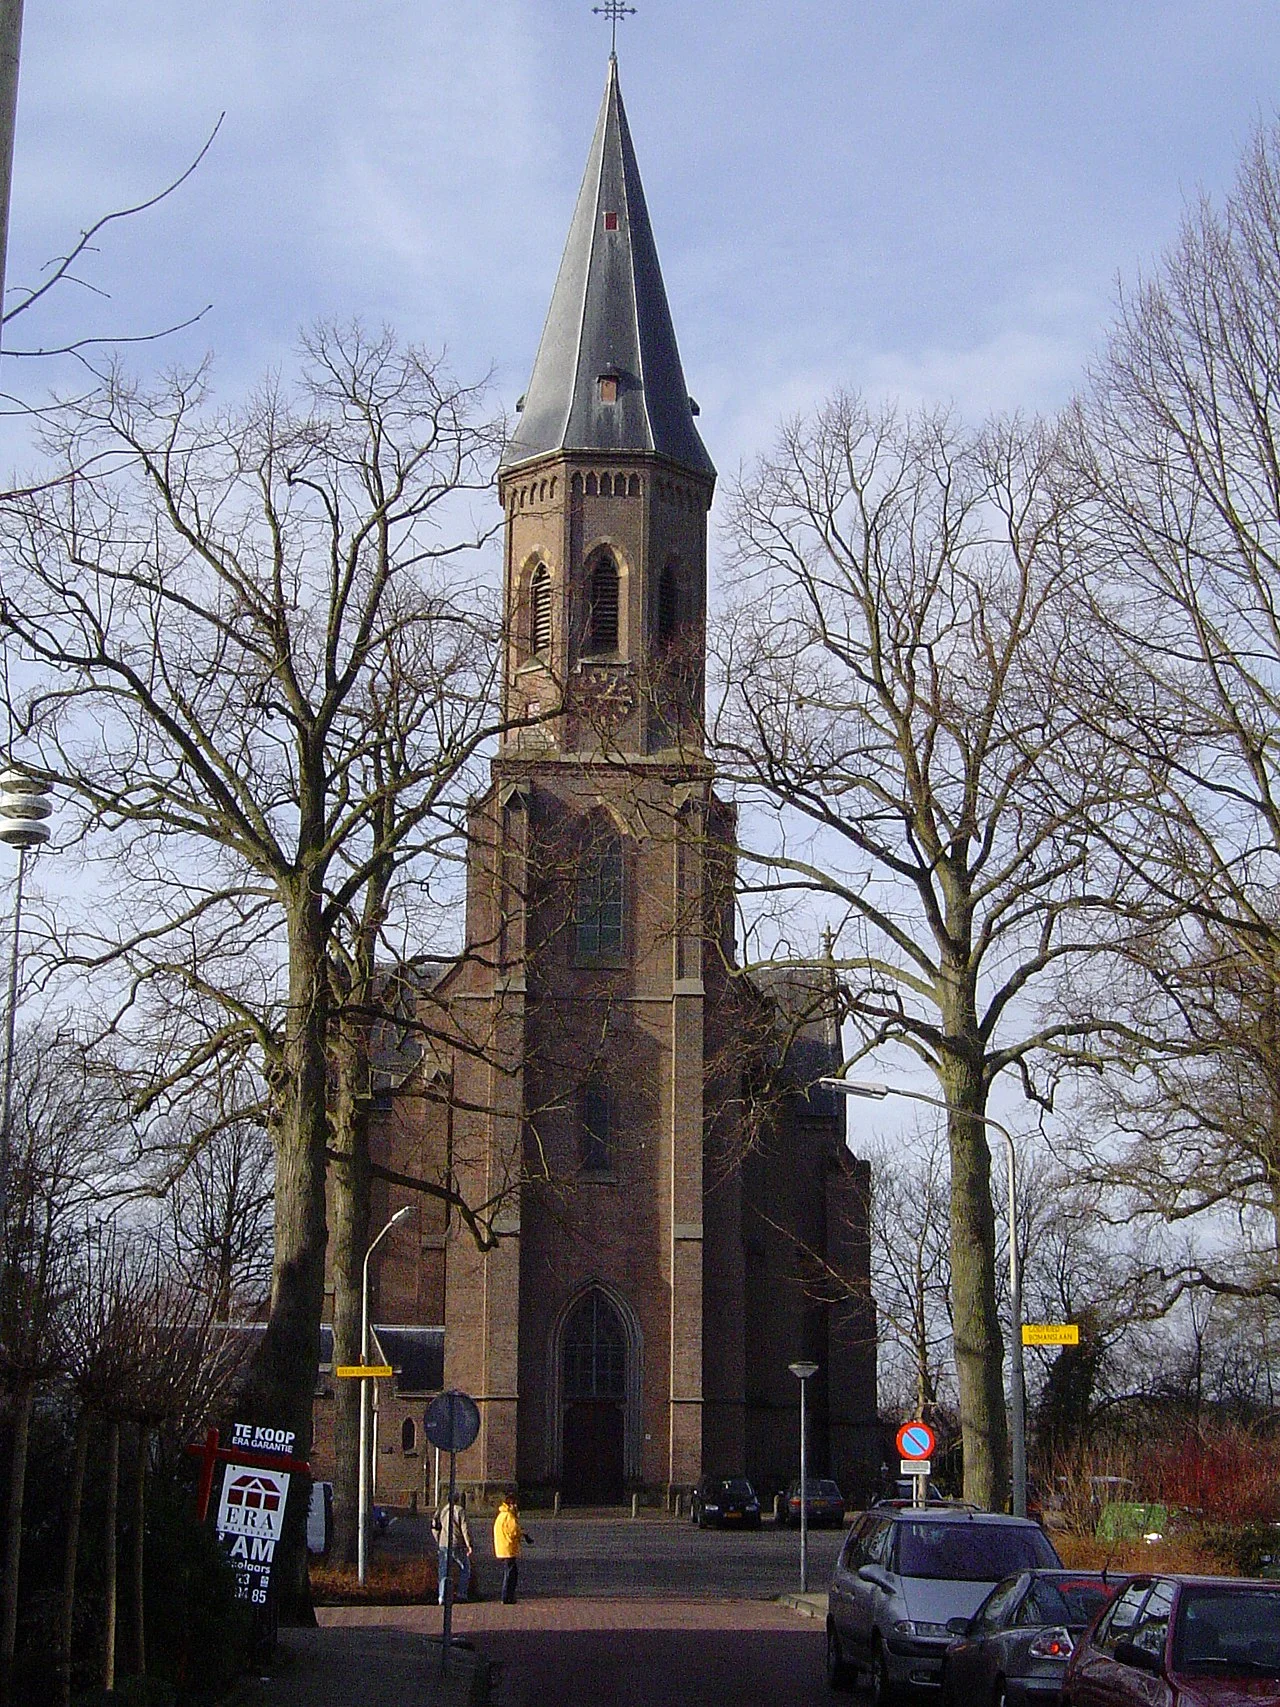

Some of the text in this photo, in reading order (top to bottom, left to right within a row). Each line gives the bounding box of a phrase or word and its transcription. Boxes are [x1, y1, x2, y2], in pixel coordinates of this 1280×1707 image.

[234, 1423, 296, 1444] TE KOOP
[231, 1436, 294, 1454] ERA GARANTIE
[225, 1506, 274, 1531] ERA
